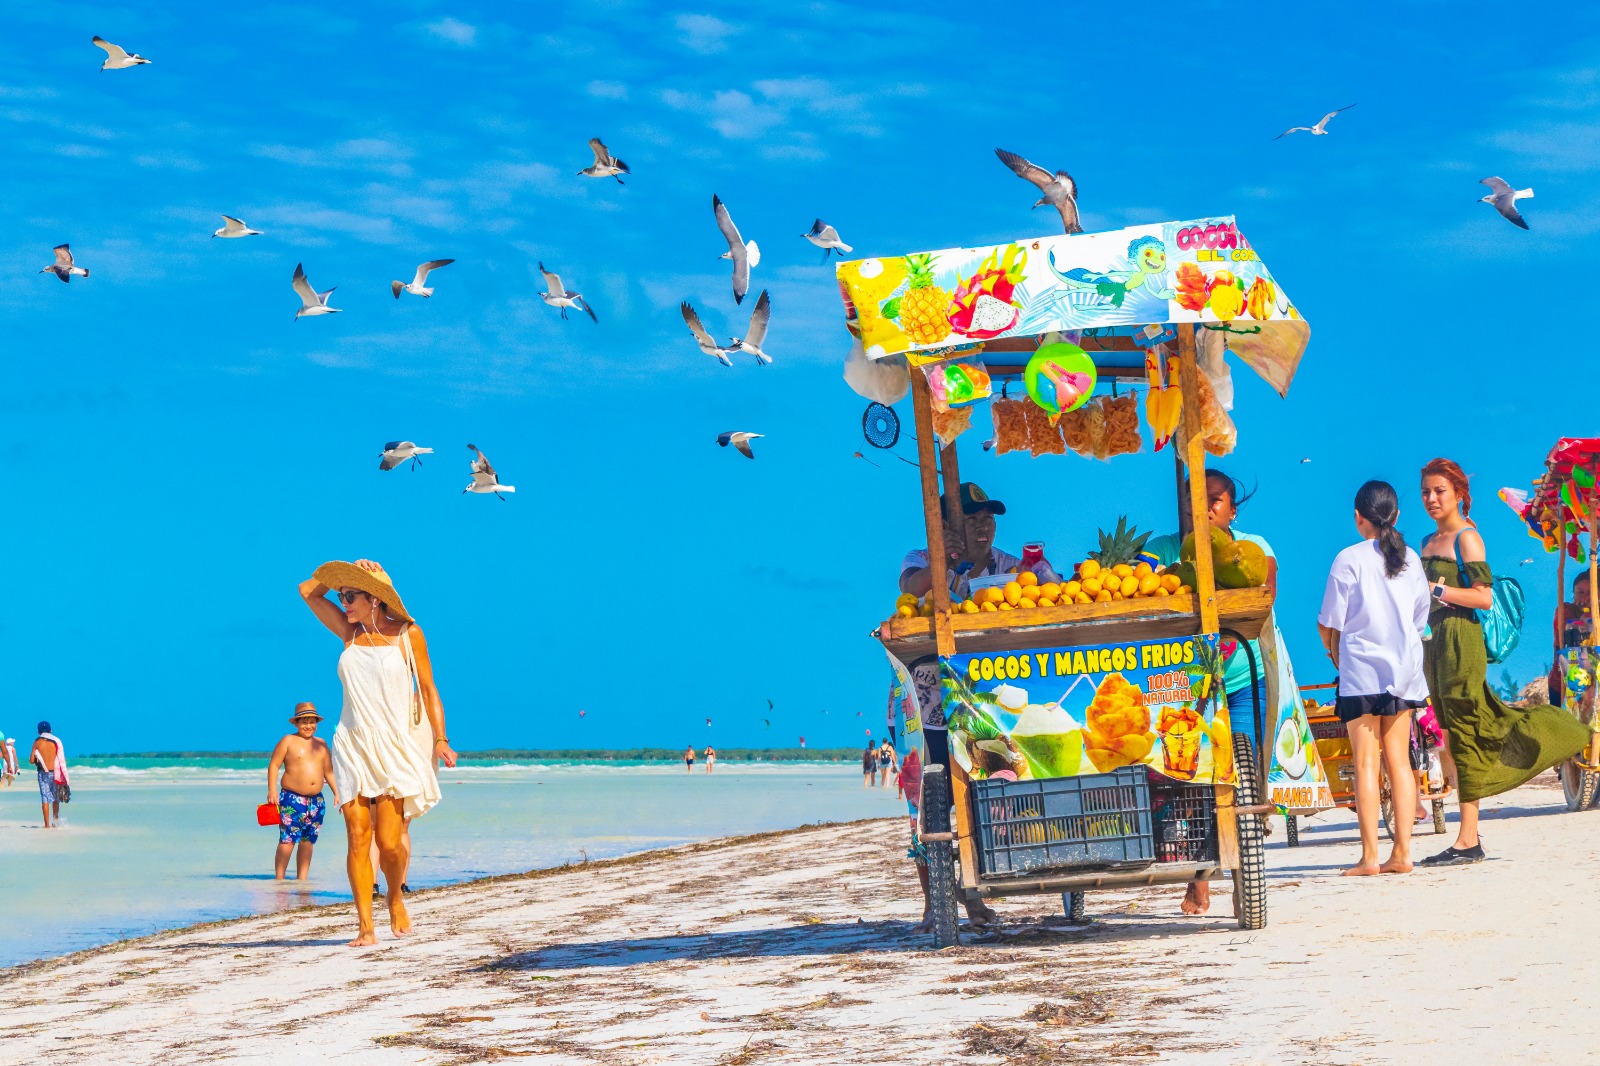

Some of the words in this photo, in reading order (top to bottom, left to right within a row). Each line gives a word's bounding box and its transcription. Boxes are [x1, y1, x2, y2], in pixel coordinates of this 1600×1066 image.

[1177, 222, 1237, 250] COCOS
[1197, 249, 1224, 262] EL
[968, 654, 1031, 681] COCOS
[1035, 653, 1049, 677] Y
[1054, 646, 1137, 677] MANGOS
[1141, 640, 1194, 669] FRIOS
[1148, 671, 1189, 691] 100%
[1142, 688, 1195, 706] NATURAL
